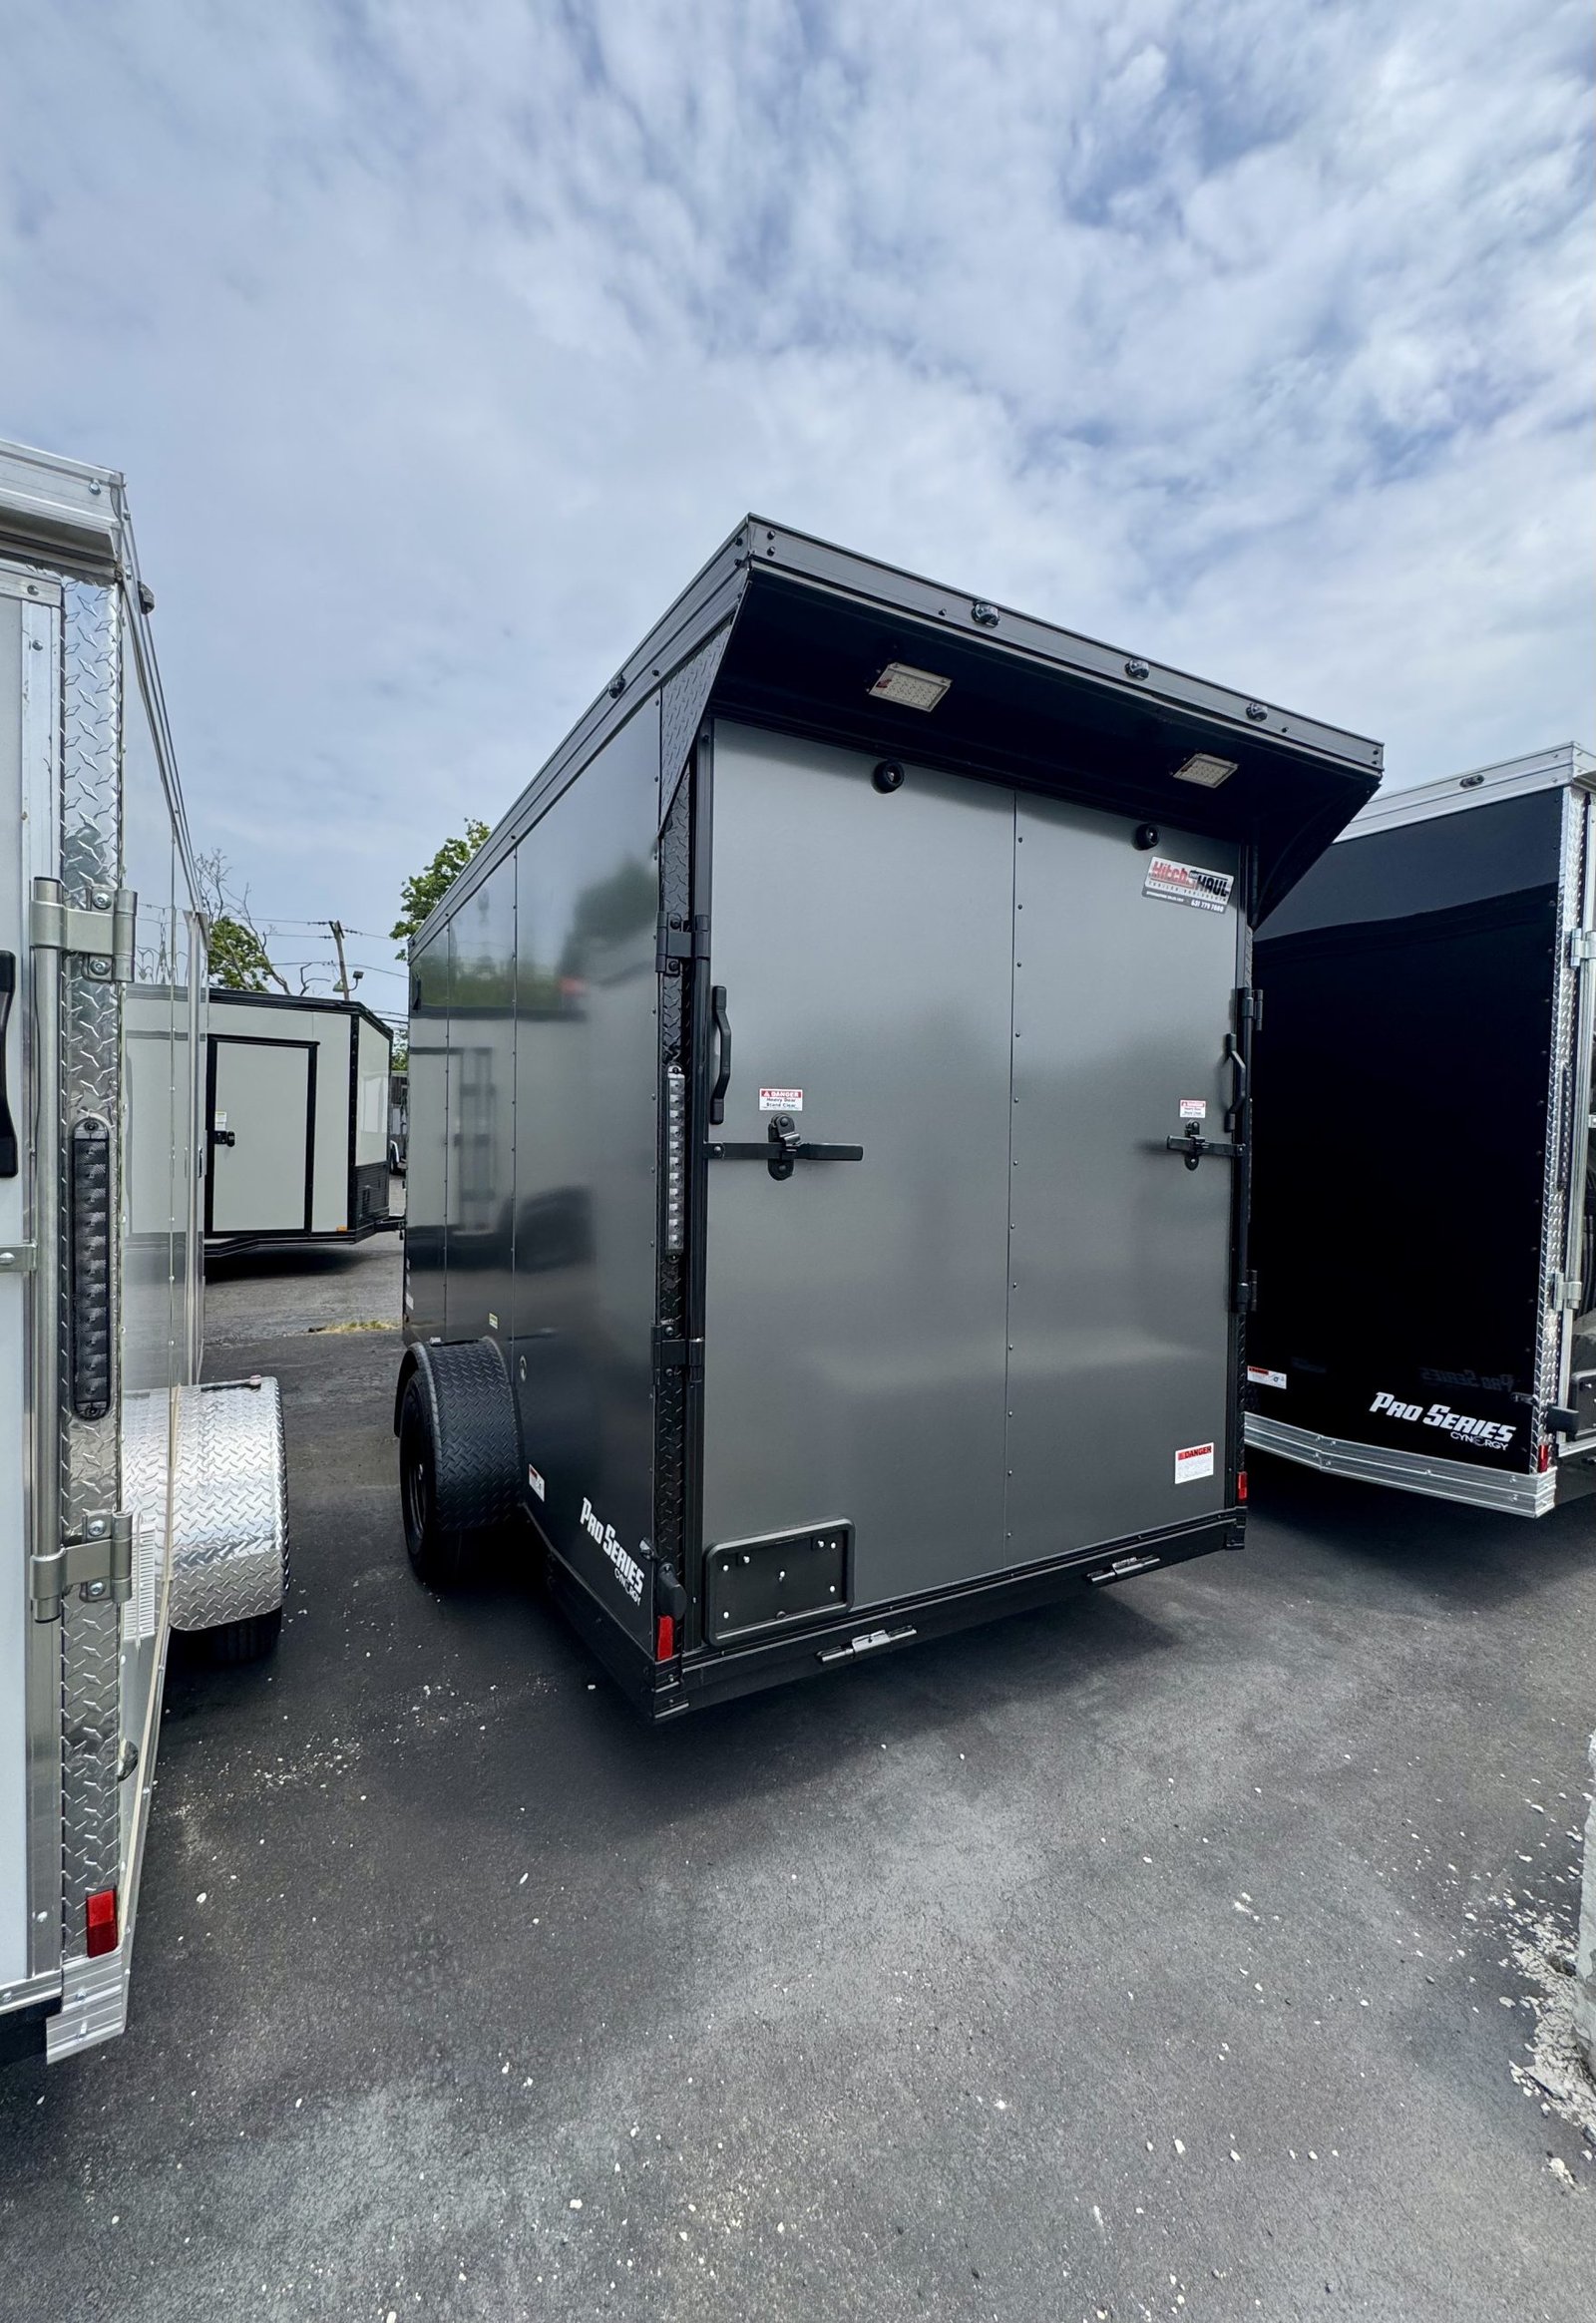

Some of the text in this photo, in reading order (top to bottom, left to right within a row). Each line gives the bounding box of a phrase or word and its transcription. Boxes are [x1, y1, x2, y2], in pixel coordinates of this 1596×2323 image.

[1151, 861, 1188, 884] Hitch
[1198, 875, 1228, 897] HAUL
[1450, 1431, 1508, 1450] CYNERGY
[1184, 1445, 1212, 1458] DANGER
